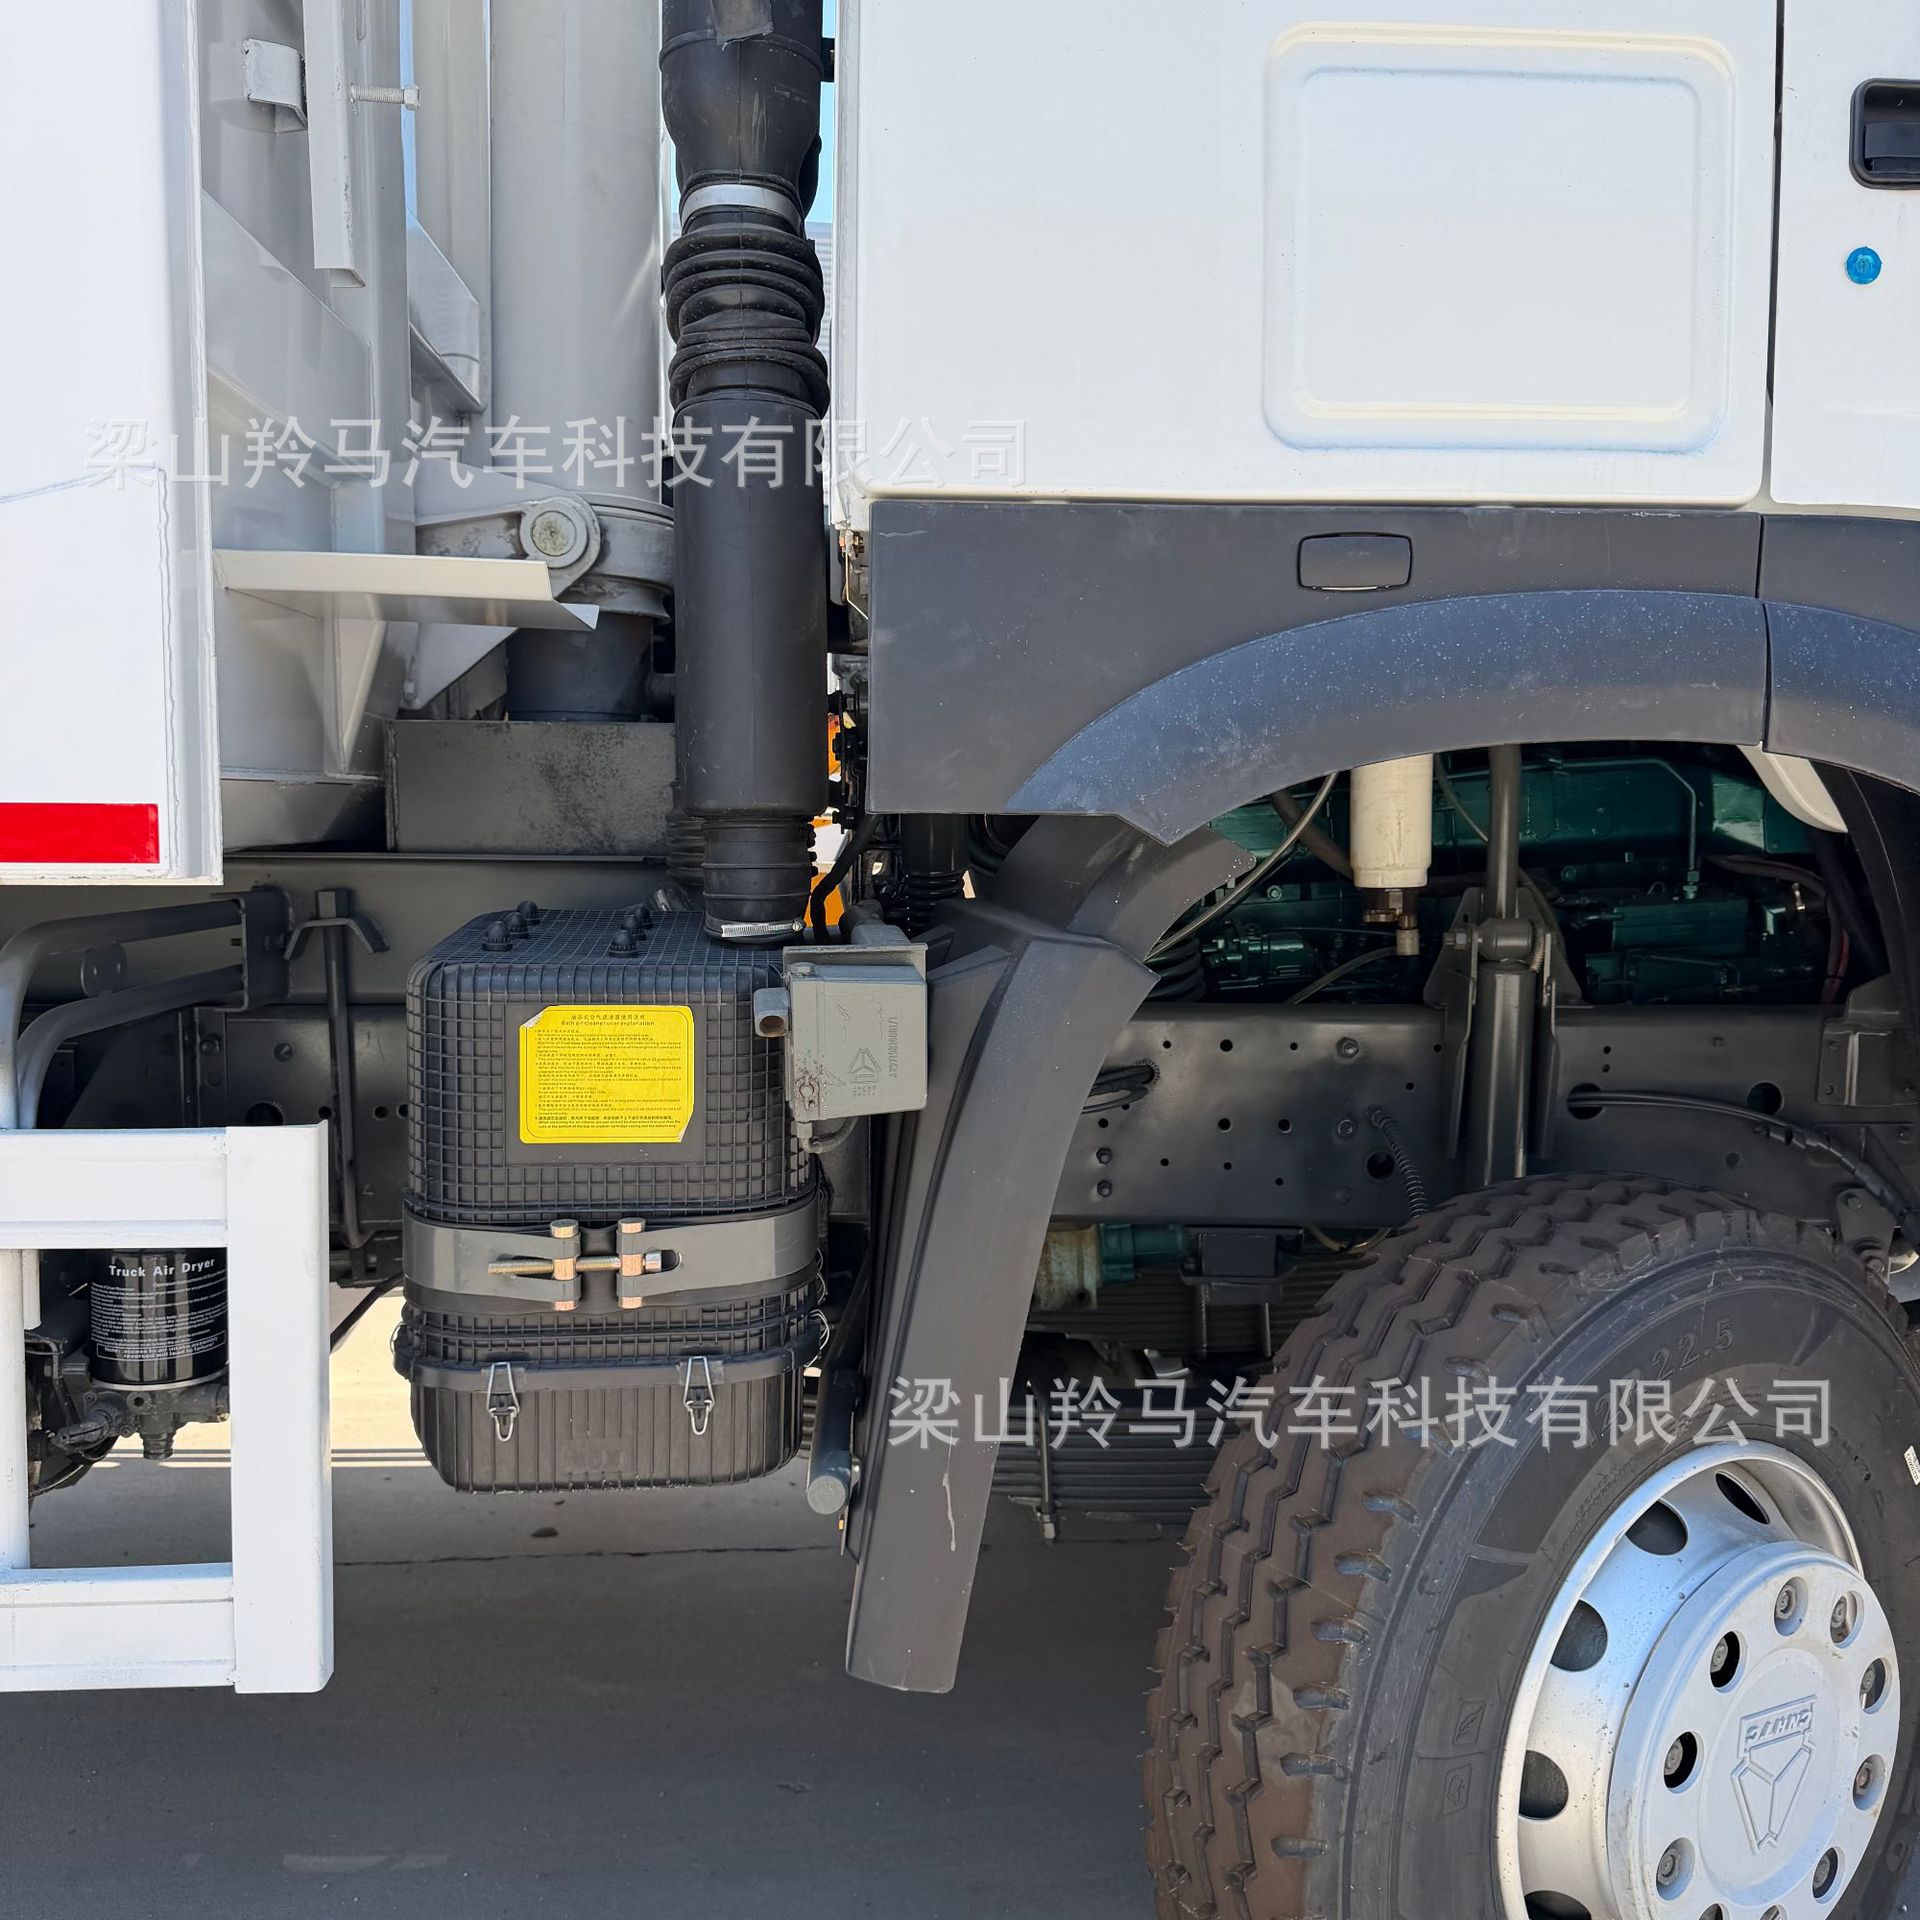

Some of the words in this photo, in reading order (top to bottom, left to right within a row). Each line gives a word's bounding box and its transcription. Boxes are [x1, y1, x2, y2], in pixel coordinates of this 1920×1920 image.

[109, 1265, 145, 1277] Truck
[153, 1265, 175, 1277] Air
[181, 1259, 215, 1274] Dryer
